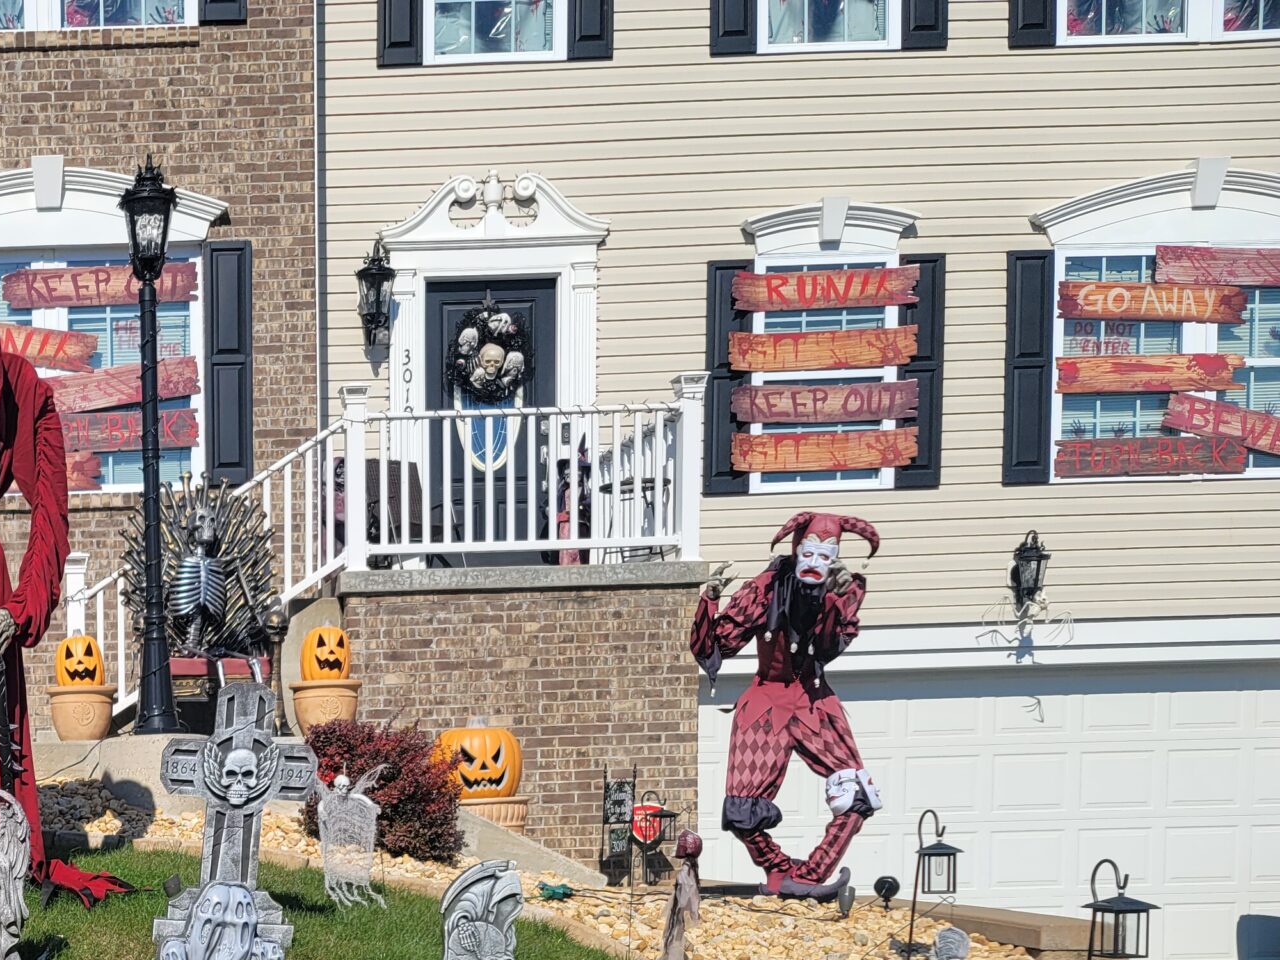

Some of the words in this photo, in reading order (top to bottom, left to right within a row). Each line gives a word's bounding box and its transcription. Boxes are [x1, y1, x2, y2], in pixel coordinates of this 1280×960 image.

[24, 269, 112, 304] KEEP
[1078, 284, 1131, 313] GO
[1140, 284, 1219, 318] AWAY
[1073, 321, 1095, 335] DO
[1105, 321, 1136, 336] NOT
[1081, 338, 1131, 354] ENTER
[750, 388, 829, 421] KEEP
[841, 387, 902, 418] OUT
[106, 411, 181, 447] BAK
[1157, 438, 1232, 472] BACK
[164, 760, 198, 776] 1864
[279, 768, 314, 783] 1947
